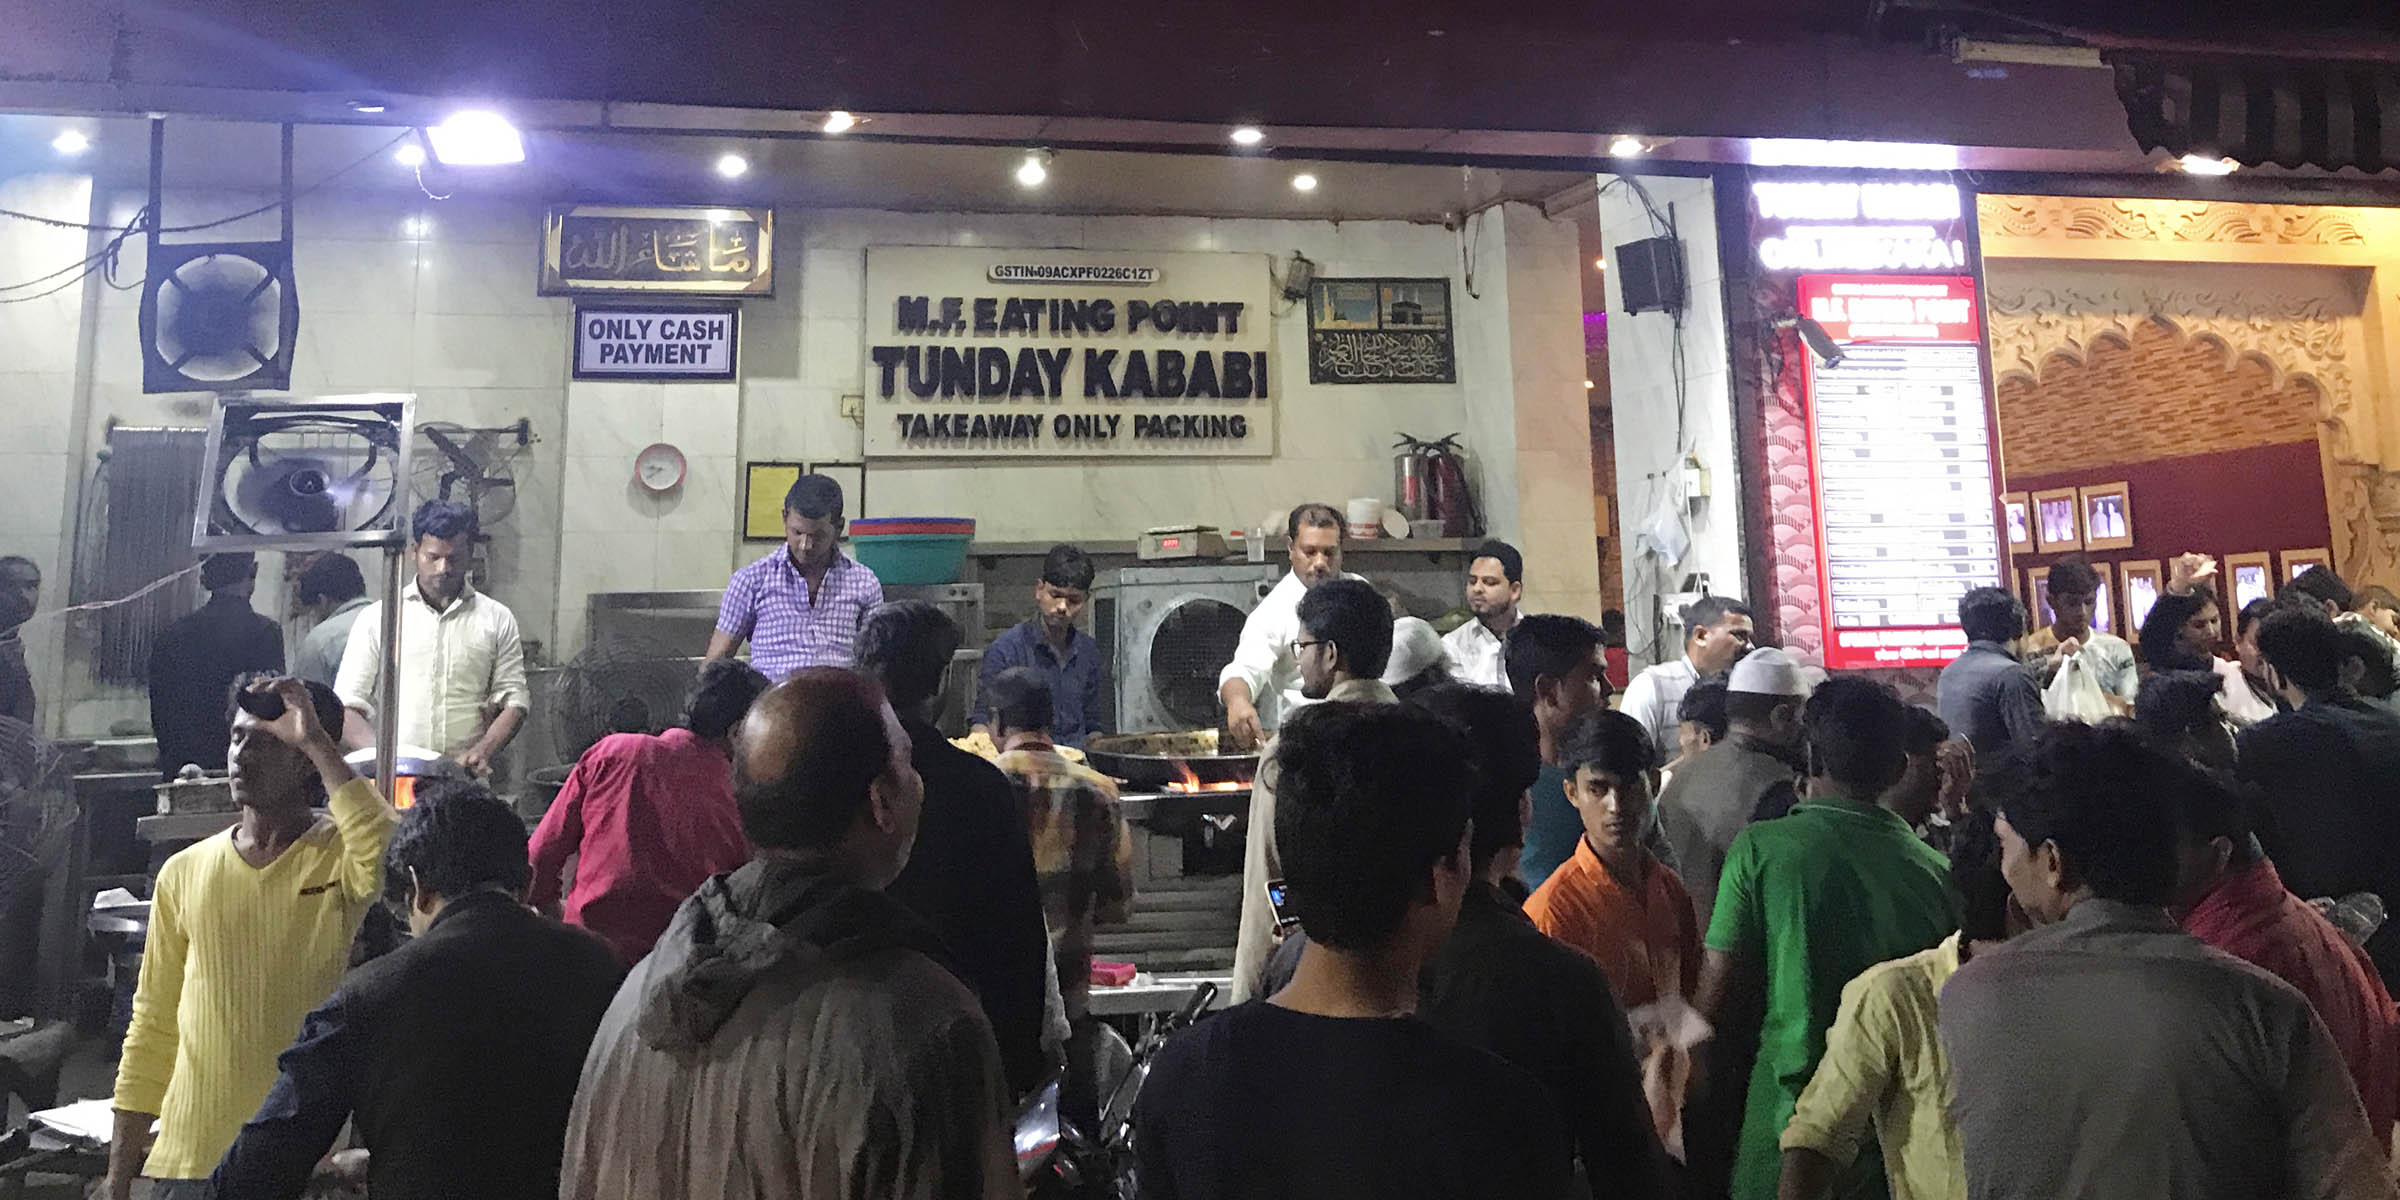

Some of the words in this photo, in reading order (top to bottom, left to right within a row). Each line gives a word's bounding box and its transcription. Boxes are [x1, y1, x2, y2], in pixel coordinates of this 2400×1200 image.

[588, 318, 653, 340] ONLY
[660, 319, 724, 341] CASH
[973, 297, 1116, 334] EATING
[1127, 299, 1245, 336] POINT
[600, 343, 712, 364] PAYMENT
[872, 345, 1072, 401] TUNDAY
[1083, 347, 1268, 400] KABABI
[897, 412, 1043, 439] TAKEAWAY
[1053, 413, 1121, 439] ONLY
[1133, 414, 1247, 439] PACKING
